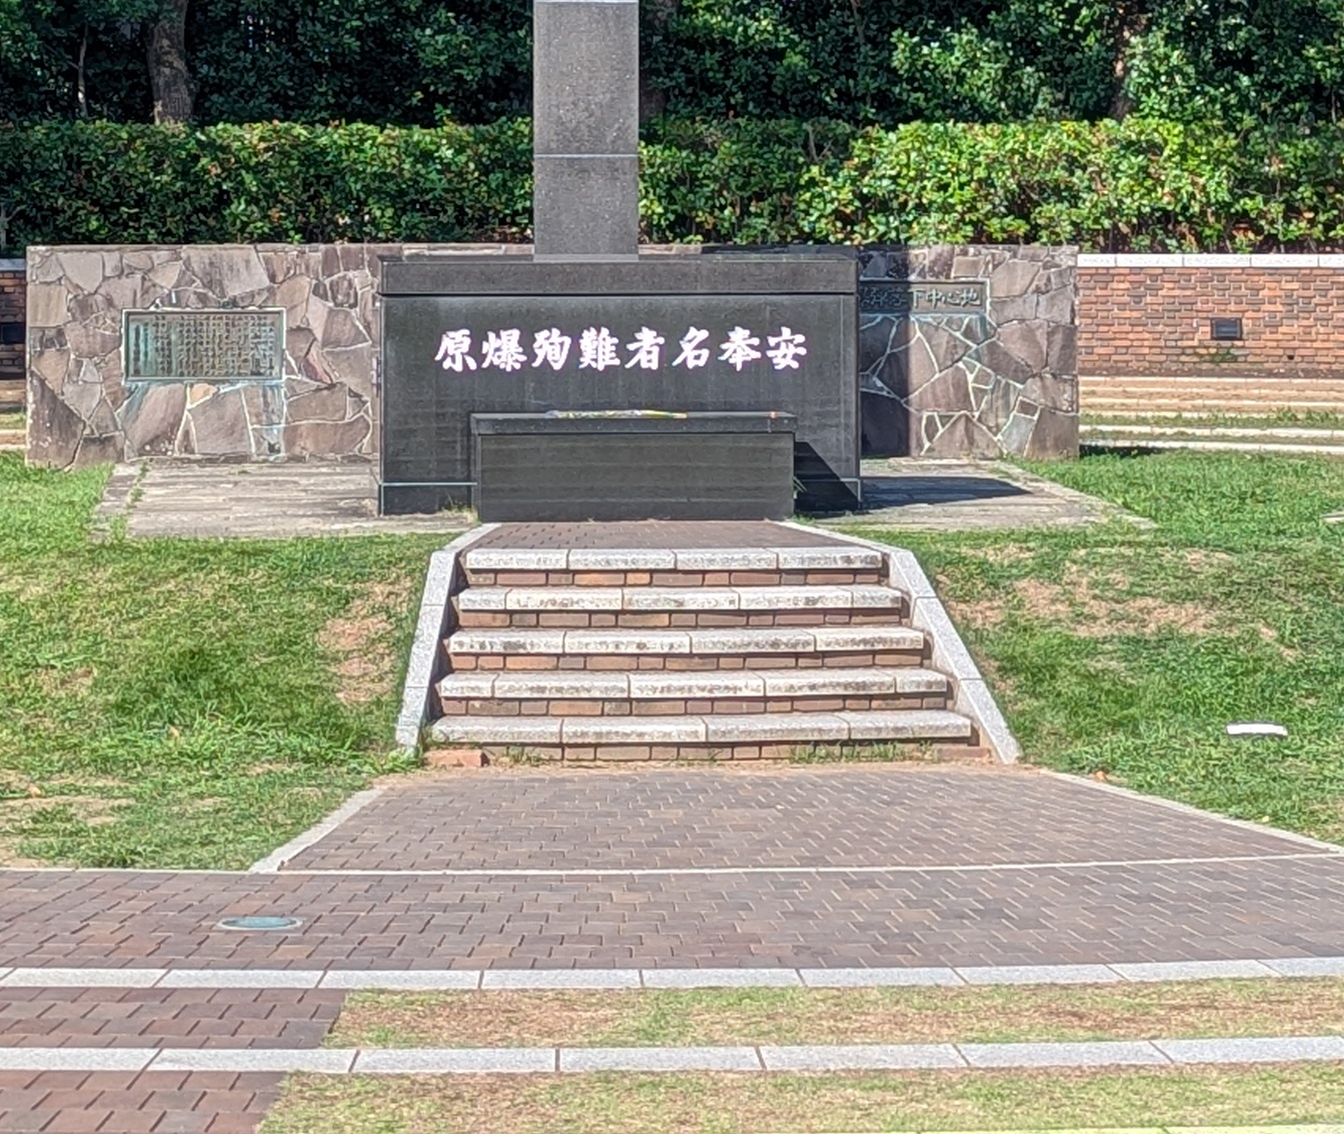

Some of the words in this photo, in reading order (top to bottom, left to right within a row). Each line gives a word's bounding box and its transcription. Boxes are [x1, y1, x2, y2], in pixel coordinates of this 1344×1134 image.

[434, 326, 807, 372] 原爆殉難者名奉安
